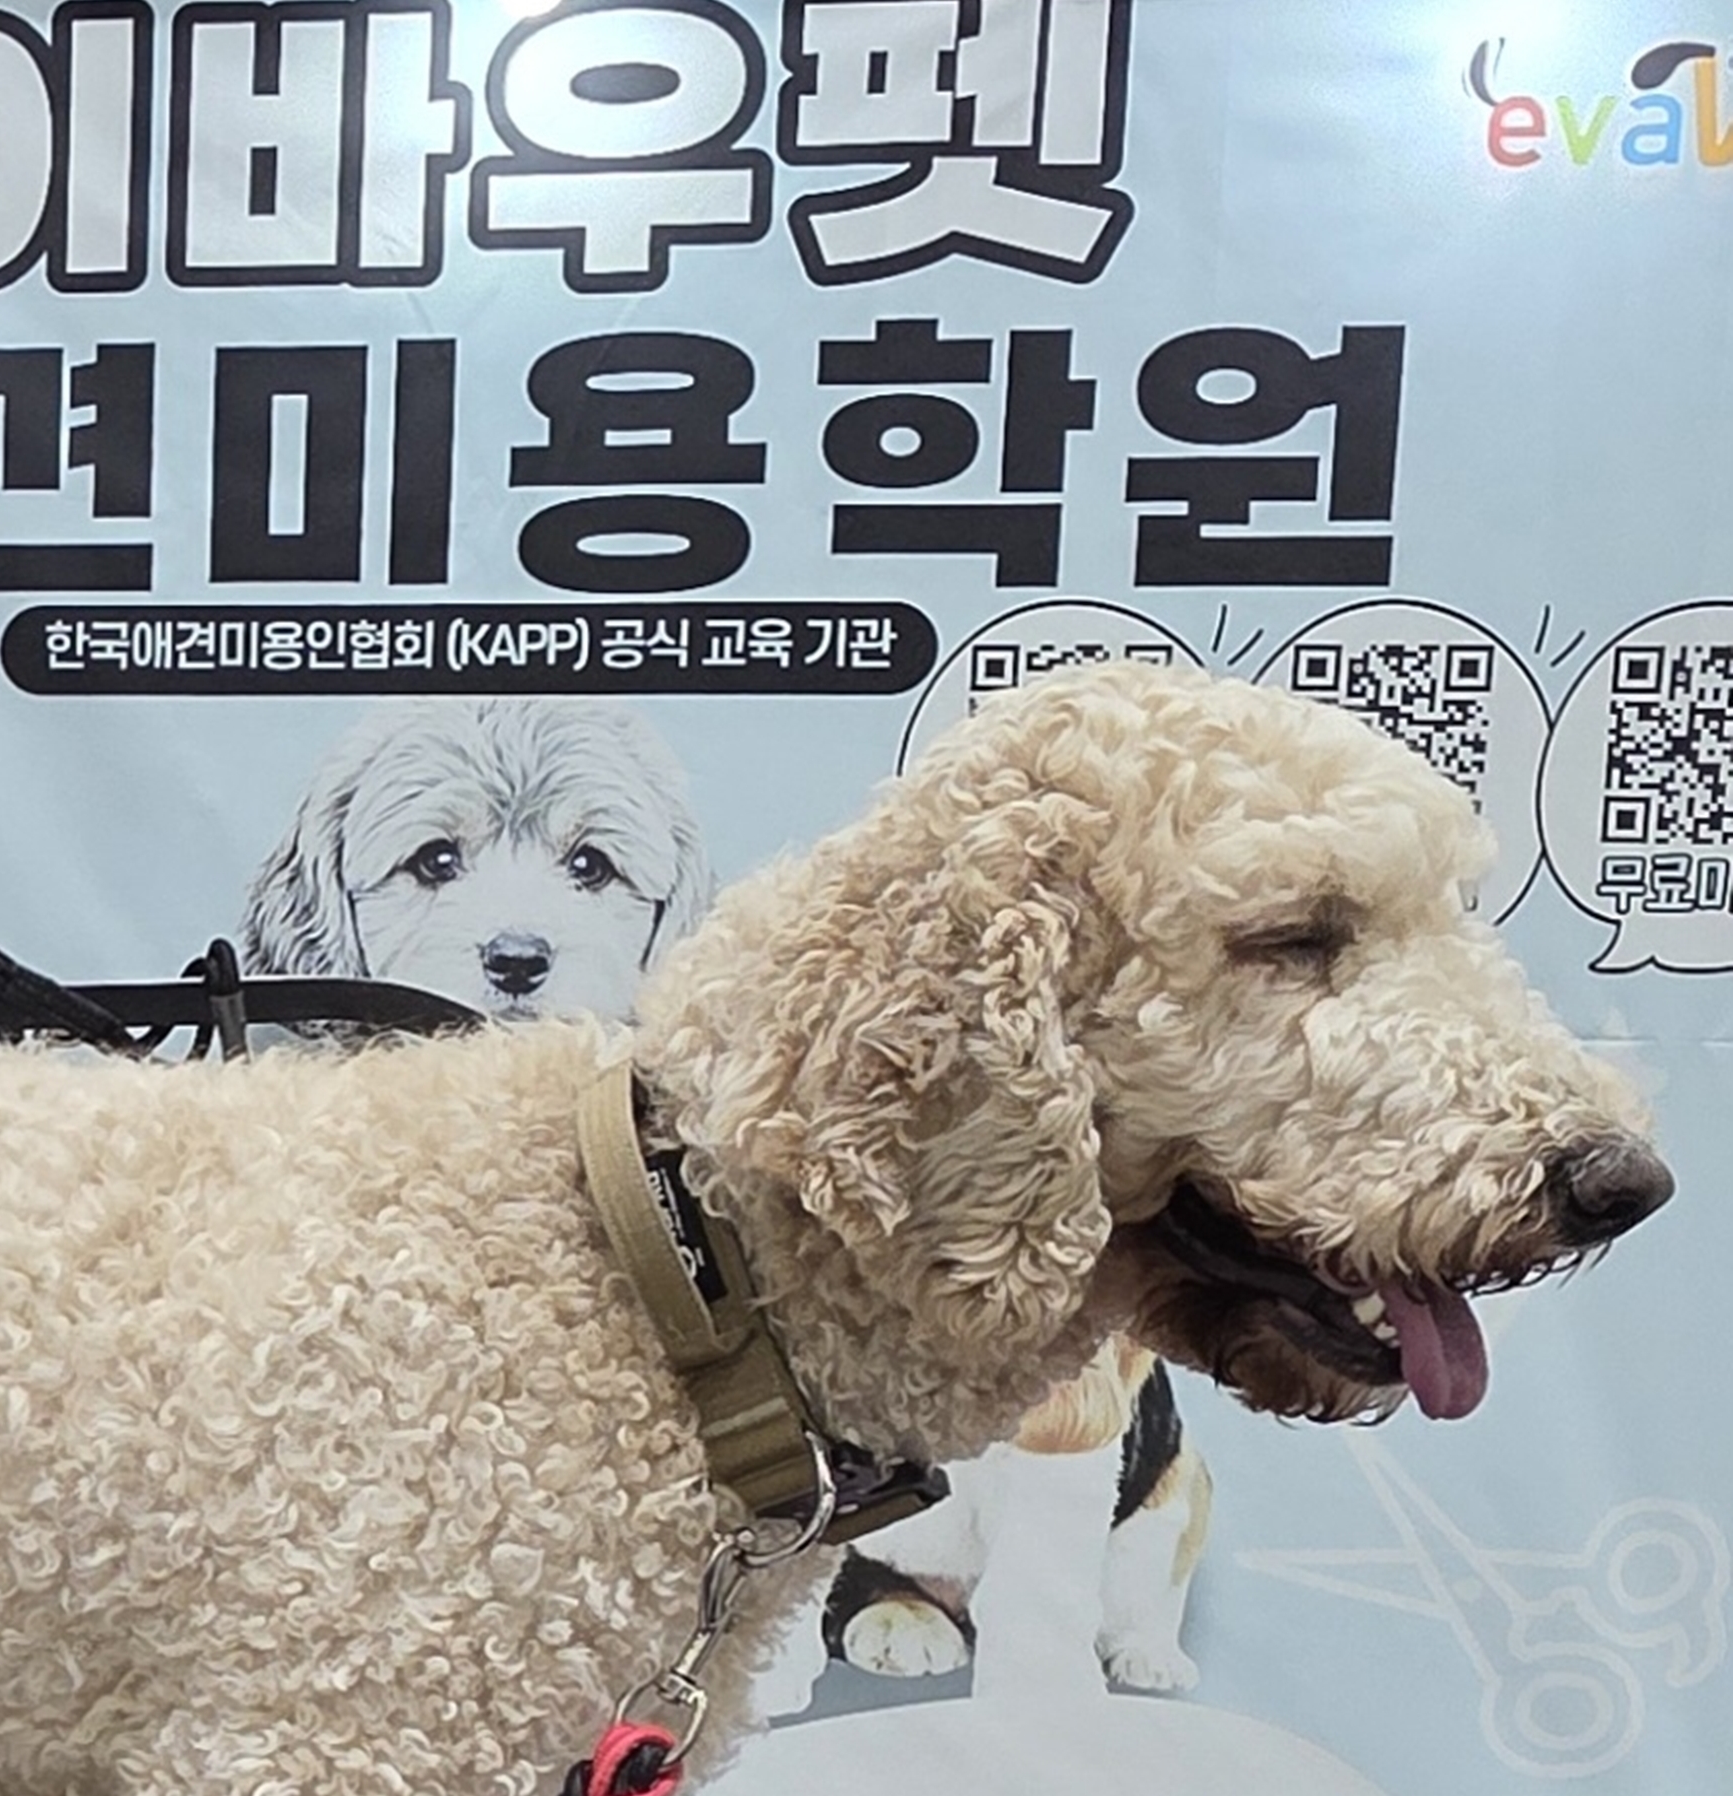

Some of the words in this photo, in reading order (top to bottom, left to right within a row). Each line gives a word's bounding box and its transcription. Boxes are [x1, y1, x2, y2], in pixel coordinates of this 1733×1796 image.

[45, 620, 436, 672] 한국애견미용인협회
[447, 617, 590, 672] (KAPP)
[601, 619, 691, 671] 공식
[702, 617, 793, 669] 교육
[804, 617, 898, 671] 기관
